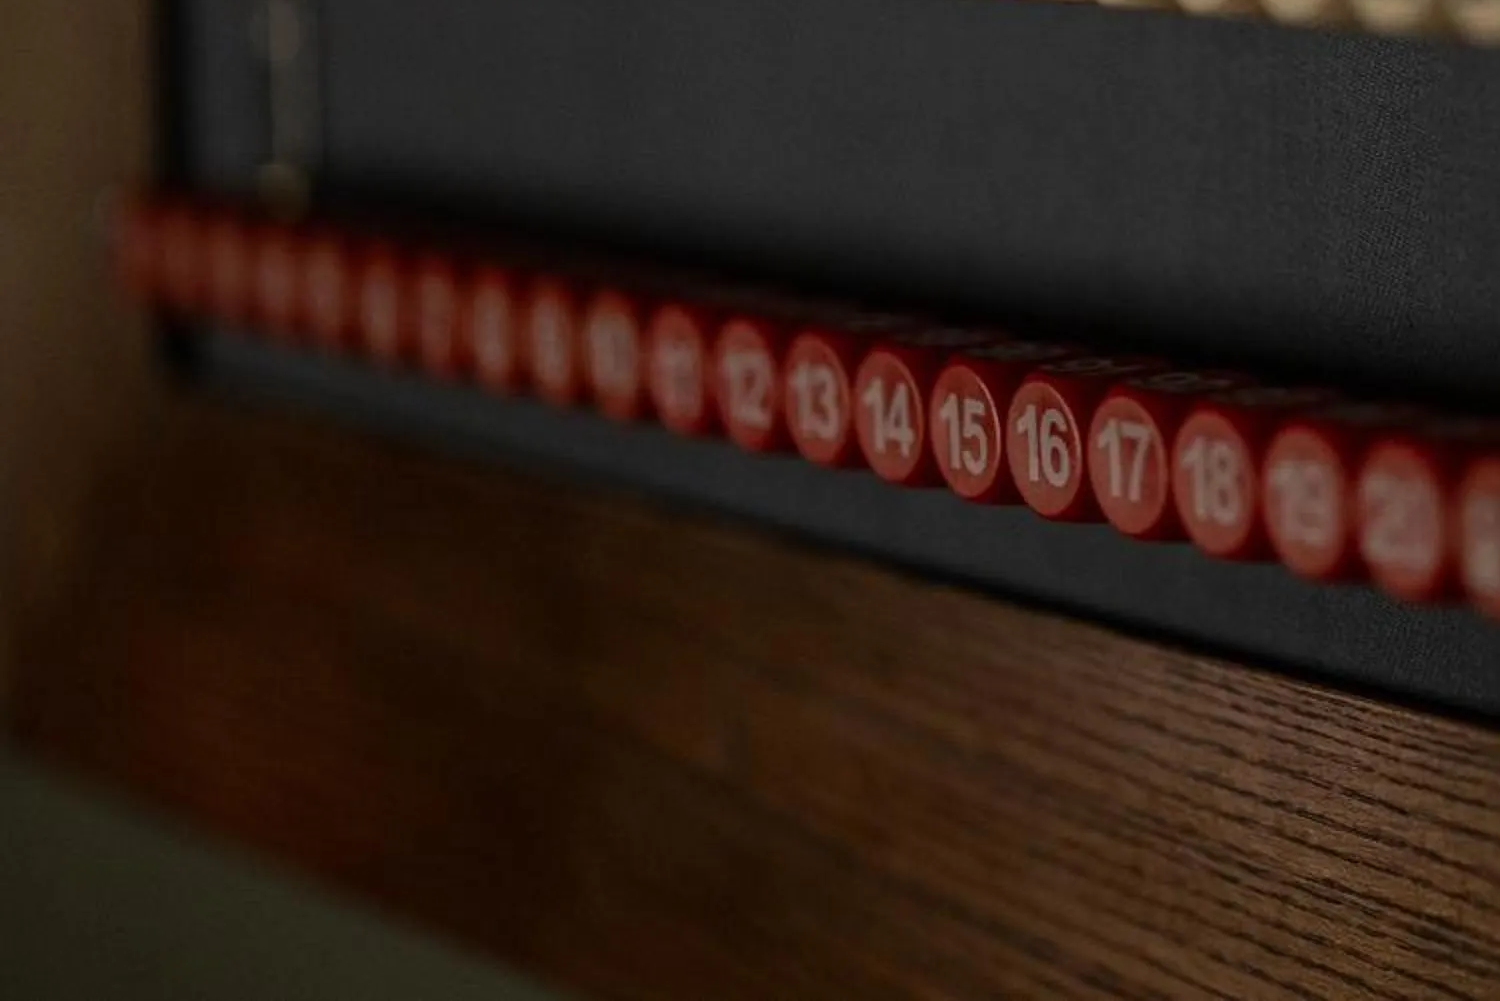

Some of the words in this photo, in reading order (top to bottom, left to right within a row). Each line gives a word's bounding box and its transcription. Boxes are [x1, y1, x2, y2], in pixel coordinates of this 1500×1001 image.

[721, 350, 776, 428] 12
[787, 362, 841, 442] 13
[862, 375, 916, 458] 14
[939, 392, 988, 477] 15
[1016, 402, 1071, 488] 16
[1098, 418, 1153, 502] 17
[1181, 435, 1242, 527] 18
[1268, 459, 1336, 547] 19
